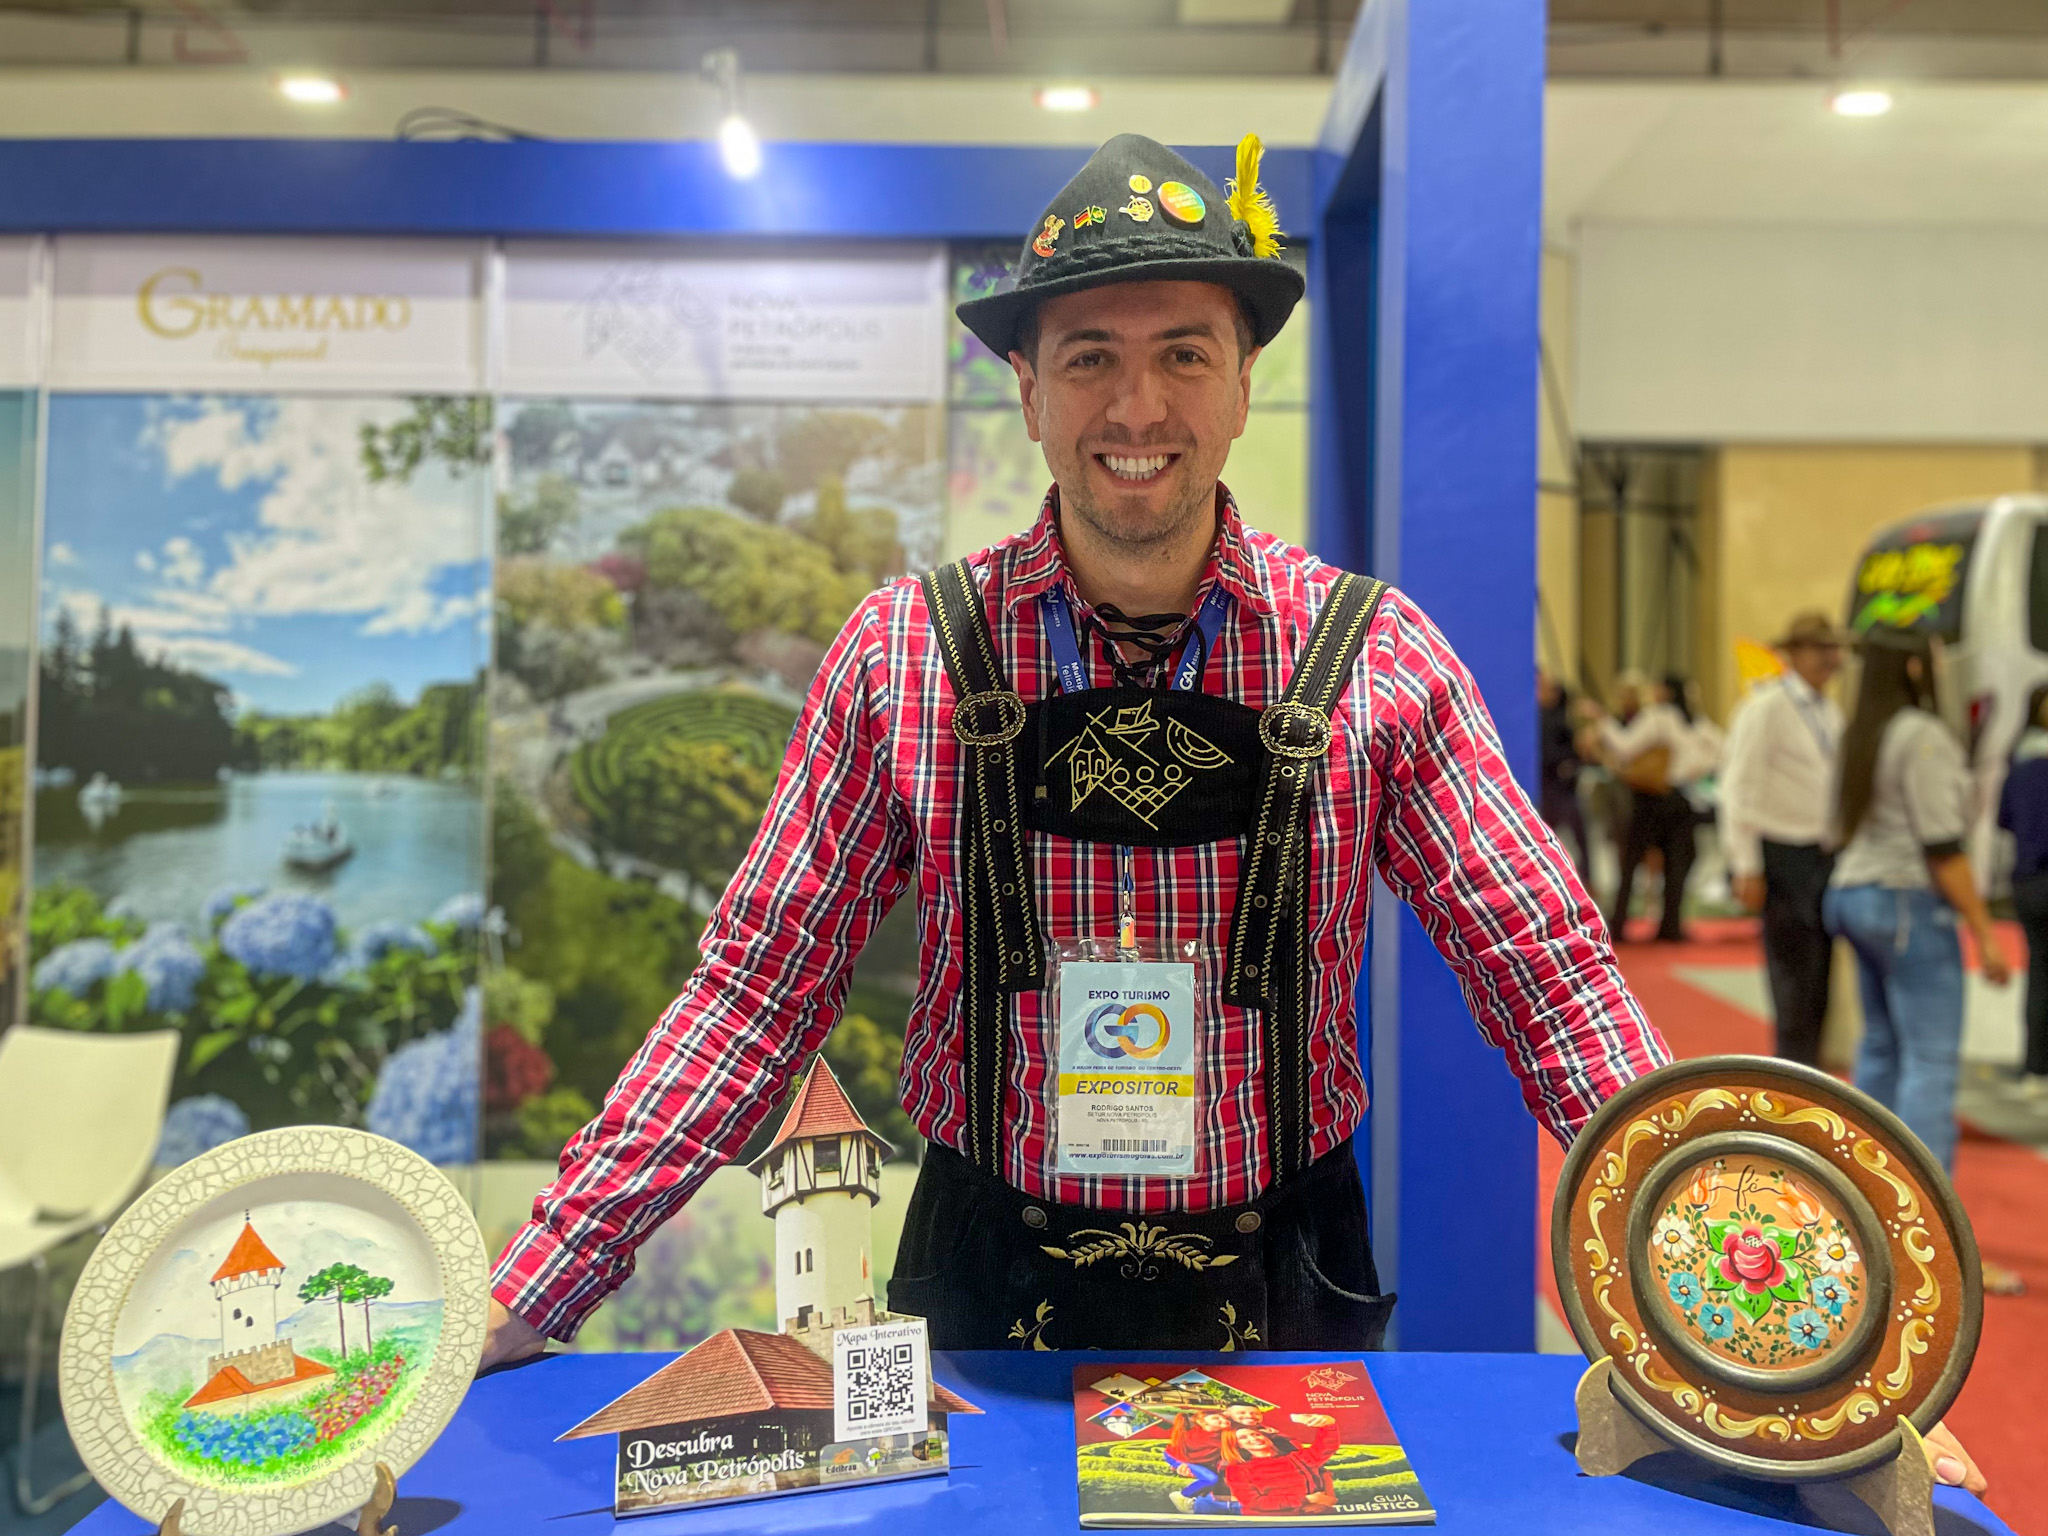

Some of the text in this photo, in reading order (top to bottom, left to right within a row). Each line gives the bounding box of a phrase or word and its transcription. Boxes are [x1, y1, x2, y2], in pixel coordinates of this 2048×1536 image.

[136, 266, 411, 340] GRAMADO
[1088, 990, 1170, 1000] EXPO TURISMO
[1076, 1080, 1178, 1095] EXPOSITOR
[1091, 1104, 1124, 1112] RODRIGO
[837, 1326, 922, 1346] Mapa Interativo
[626, 1431, 734, 1469] Descubra
[626, 1449, 805, 1496] Nova Petrópolis
[1374, 1494, 1413, 1502] GUIA
[1332, 1501, 1419, 1513] TURÍSTICO
